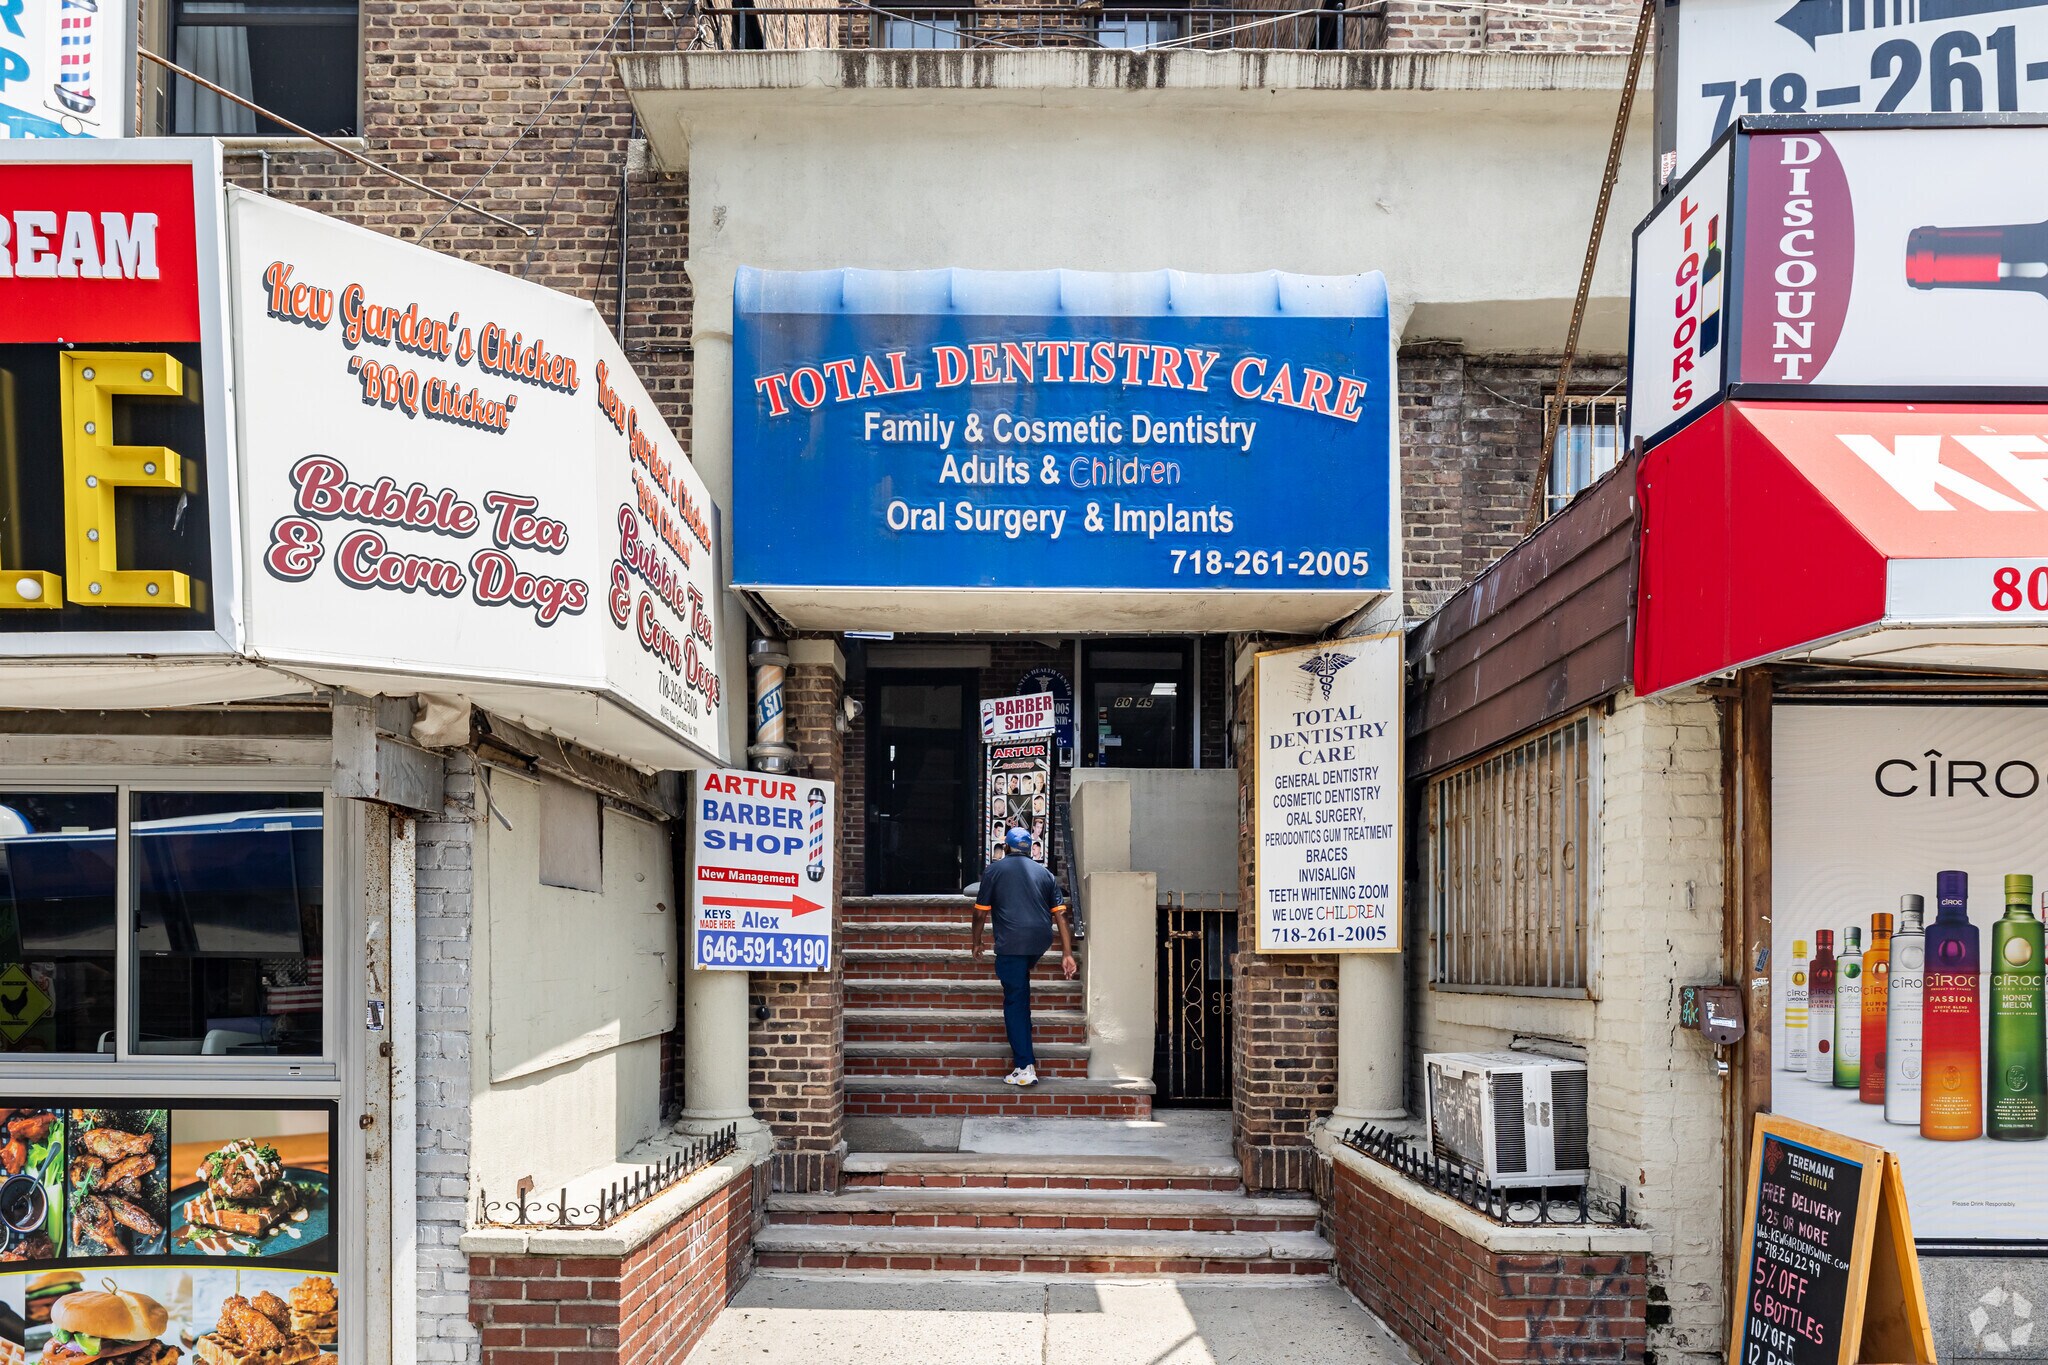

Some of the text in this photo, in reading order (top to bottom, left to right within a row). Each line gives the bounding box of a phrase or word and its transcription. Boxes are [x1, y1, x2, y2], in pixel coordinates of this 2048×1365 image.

[1772, 137, 1822, 380] DISCOUNT
[1672, 195, 1699, 411] LIQUORS
[262, 261, 580, 395] Kew Garden's Chicken
[347, 355, 518, 435] "BBQ Chicken"
[755, 341, 1368, 423] TOTAL DENTISTRY CARE
[864, 411, 1257, 451] Family & Cosmetic Dentistry
[596, 359, 712, 556] Kew Garden's Chicken
[939, 454, 1181, 488] Adults & Children
[1834, 434, 2048, 511] KE
[289, 454, 569, 554] Bubble Tea
[887, 501, 1234, 539] Oral Surgery & Implants
[263, 515, 589, 628] & Corn Dogs
[618, 502, 713, 651] Bubble Tea
[1171, 550, 1369, 576] 718-261-2005
[609, 558, 720, 715] & Corn Dogs
[995, 695, 1053, 716] BARBER
[1116, 698, 1153, 707] 80 45
[1293, 705, 1362, 727] TOTAL
[1004, 712, 1044, 730] SHOP
[1270, 721, 1388, 750] DENTISTRY
[993, 744, 1045, 758] ARTUR
[1298, 745, 1356, 766] CARE
[704, 773, 797, 801] ARTUR
[1275, 766, 1379, 790] GENERAL DENTISTRY
[1875, 749, 2048, 799] CÎRO
[1273, 786, 1381, 808] COSMETIC DENTISTRY
[703, 799, 804, 830] BARBER
[1286, 807, 1366, 826] ORAL SURGERY,
[703, 829, 804, 855] SHOP
[1265, 824, 1393, 846] PERIODONTICS GUM TREATMENT
[1306, 847, 1348, 863] BRACES
[701, 869, 795, 884] New Management
[1299, 866, 1356, 882] INVISALIGN
[1269, 884, 1389, 902] TEETH WHITENING ZOOM
[700, 920, 736, 929] MADE HERE
[704, 909, 731, 919] KEYS
[742, 911, 779, 929] Alex
[1273, 904, 1385, 921] WE LOVE CHILDREN
[1272, 925, 1387, 943] 718-261-2005
[702, 935, 825, 965] 646-591-3190
[1838, 985, 1862, 994] CÎRO
[1802, 1173, 1827, 1191] TEQUILA
[1761, 1182, 1841, 1226] FREE DELIVERY
[1783, 1215, 1794, 1231] OR
[1799, 1221, 1829, 1247] MORE
[1779, 1269, 1808, 1303] OFF
[1764, 1294, 1824, 1344] BOTTLES
[1771, 1327, 1796, 1355] OFF
